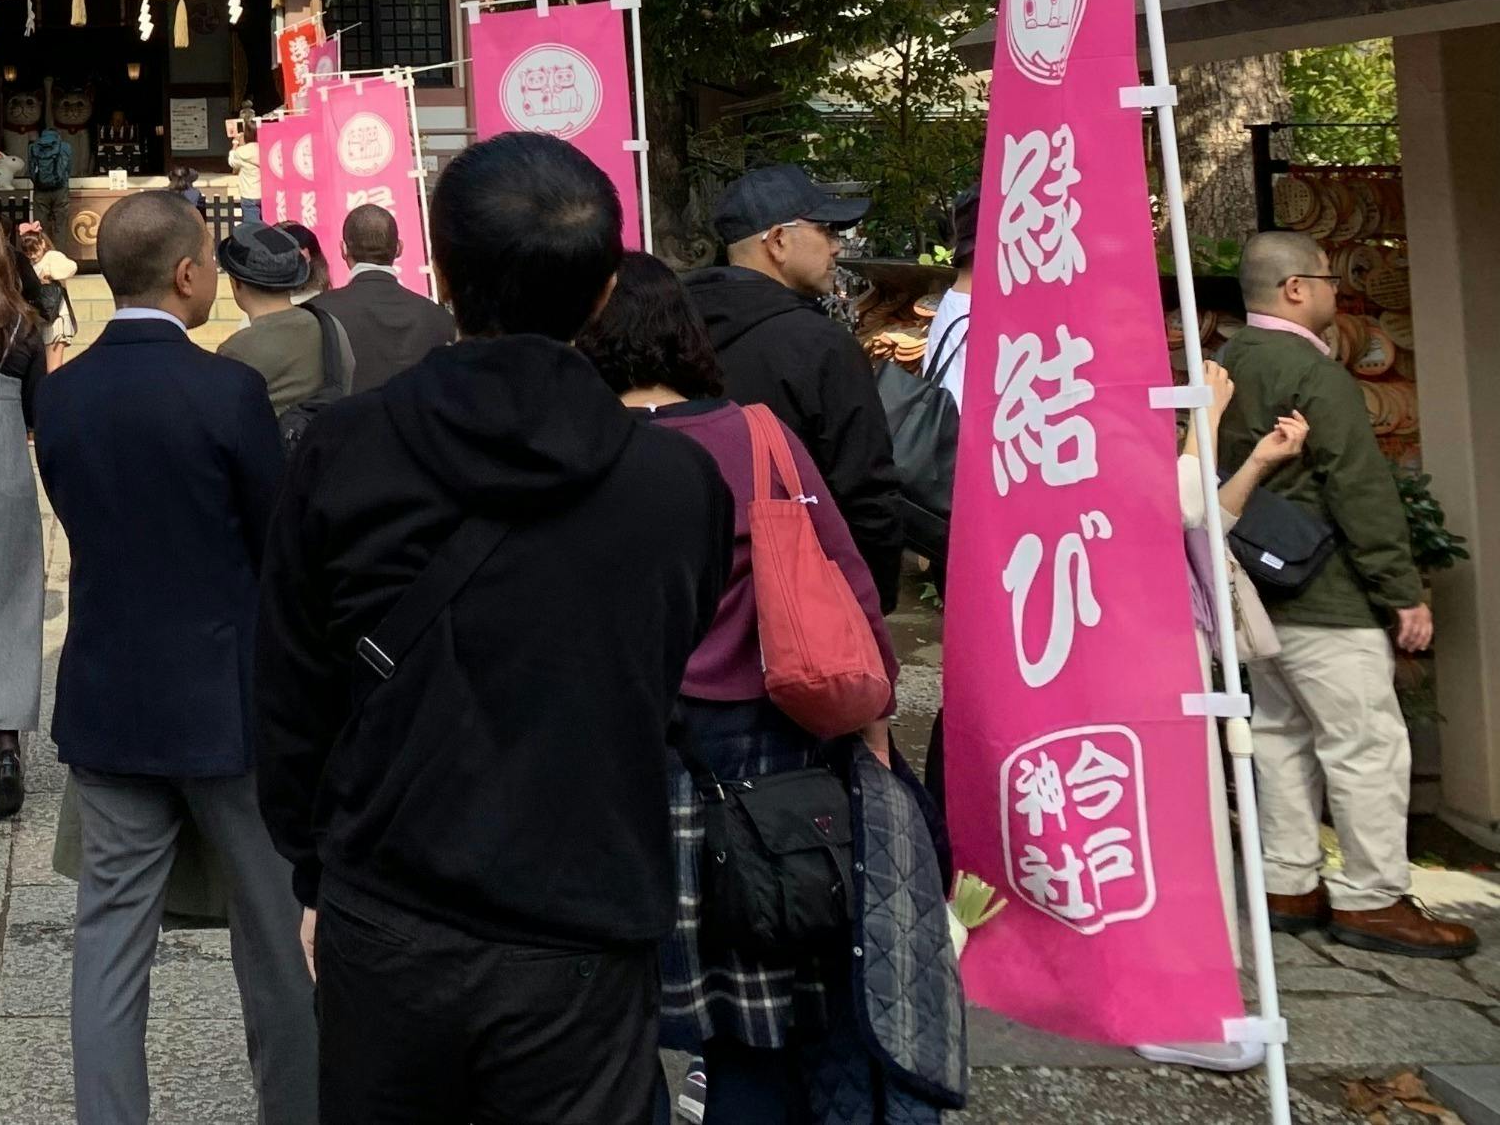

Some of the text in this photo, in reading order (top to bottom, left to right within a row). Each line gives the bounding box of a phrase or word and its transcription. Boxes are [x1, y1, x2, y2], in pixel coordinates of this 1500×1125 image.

[993, 124, 1113, 687] 縁結び
[1014, 751, 1095, 920] 神社
[1065, 740, 1137, 910] 今戸
